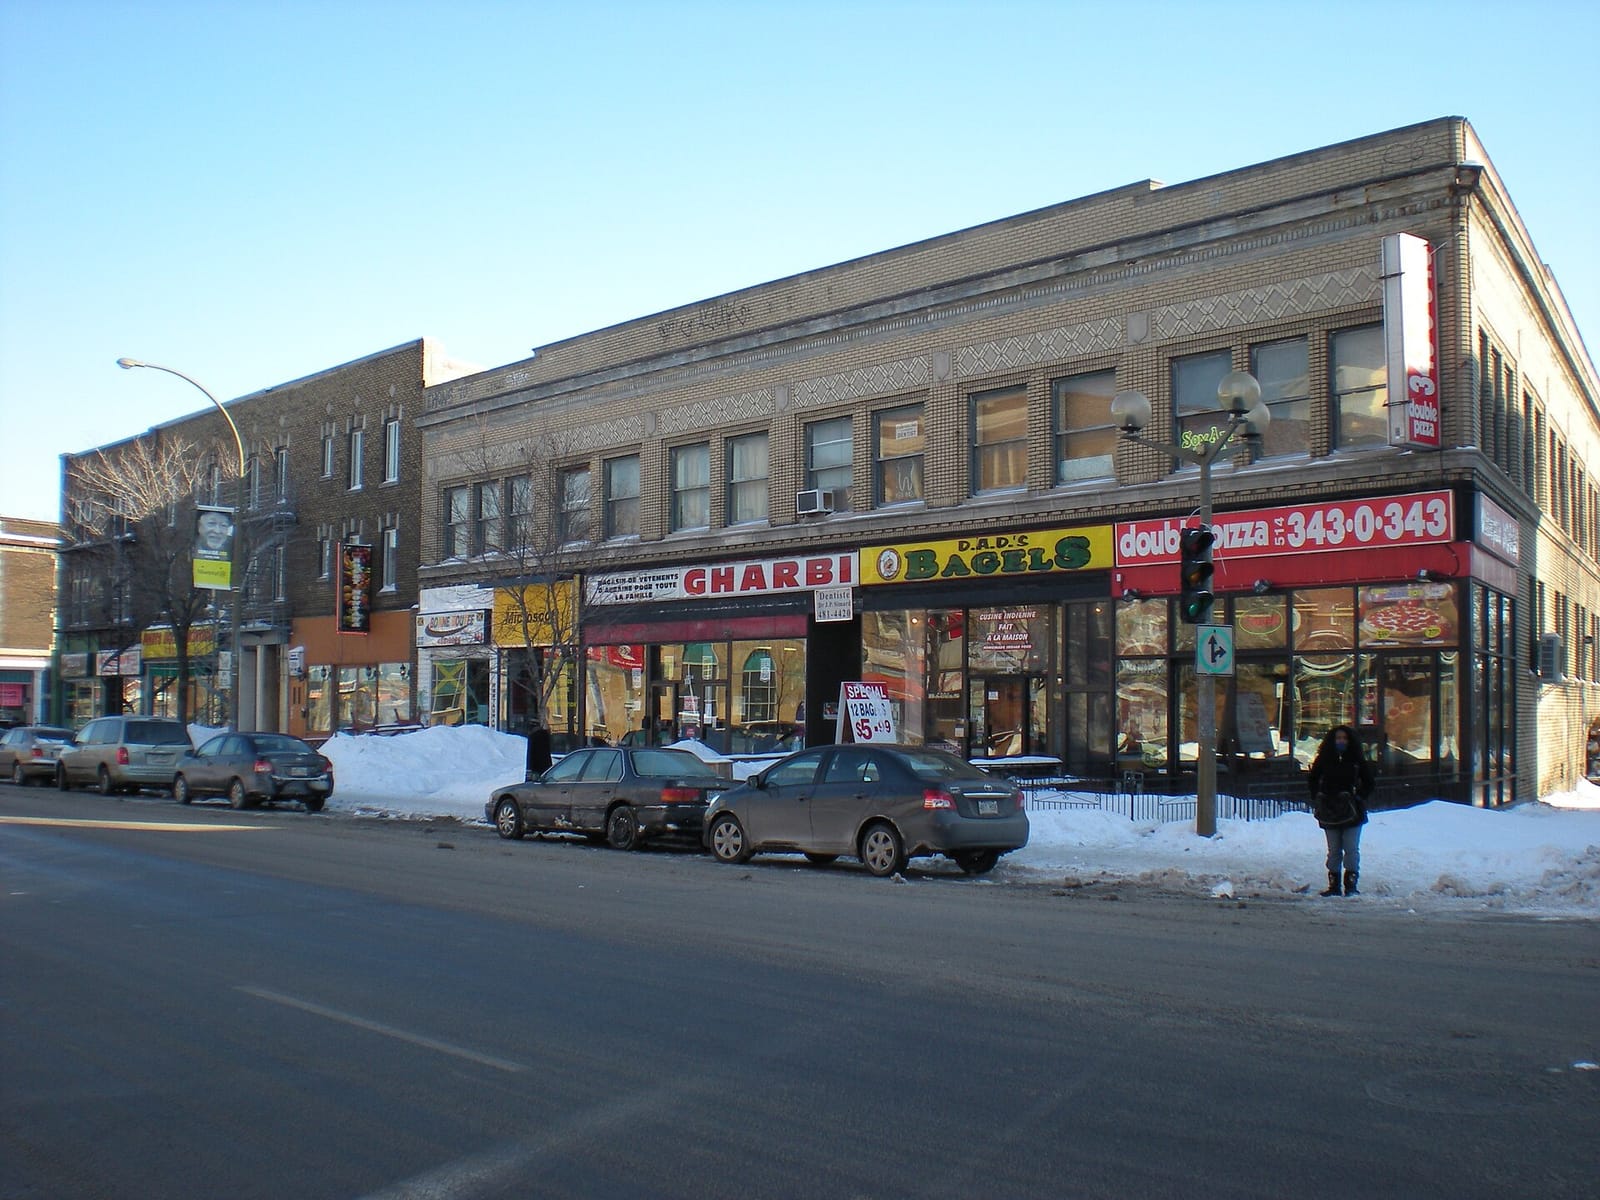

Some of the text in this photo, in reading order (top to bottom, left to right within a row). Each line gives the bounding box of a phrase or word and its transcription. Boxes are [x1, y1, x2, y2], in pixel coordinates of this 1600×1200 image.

[1408, 398, 1438, 422] double
[1119, 520, 1186, 558] doub
[1274, 517, 1285, 546] 514
[904, 535, 1092, 580] BAGELS
[683, 555, 852, 596] GHARBI
[655, 581, 678, 589] TOUTE
[626, 591, 653, 600] FAMILLE
[819, 591, 850, 600] Dentiste
[1001, 633, 1029, 641] MAISON
[850, 703, 859, 717] 12
